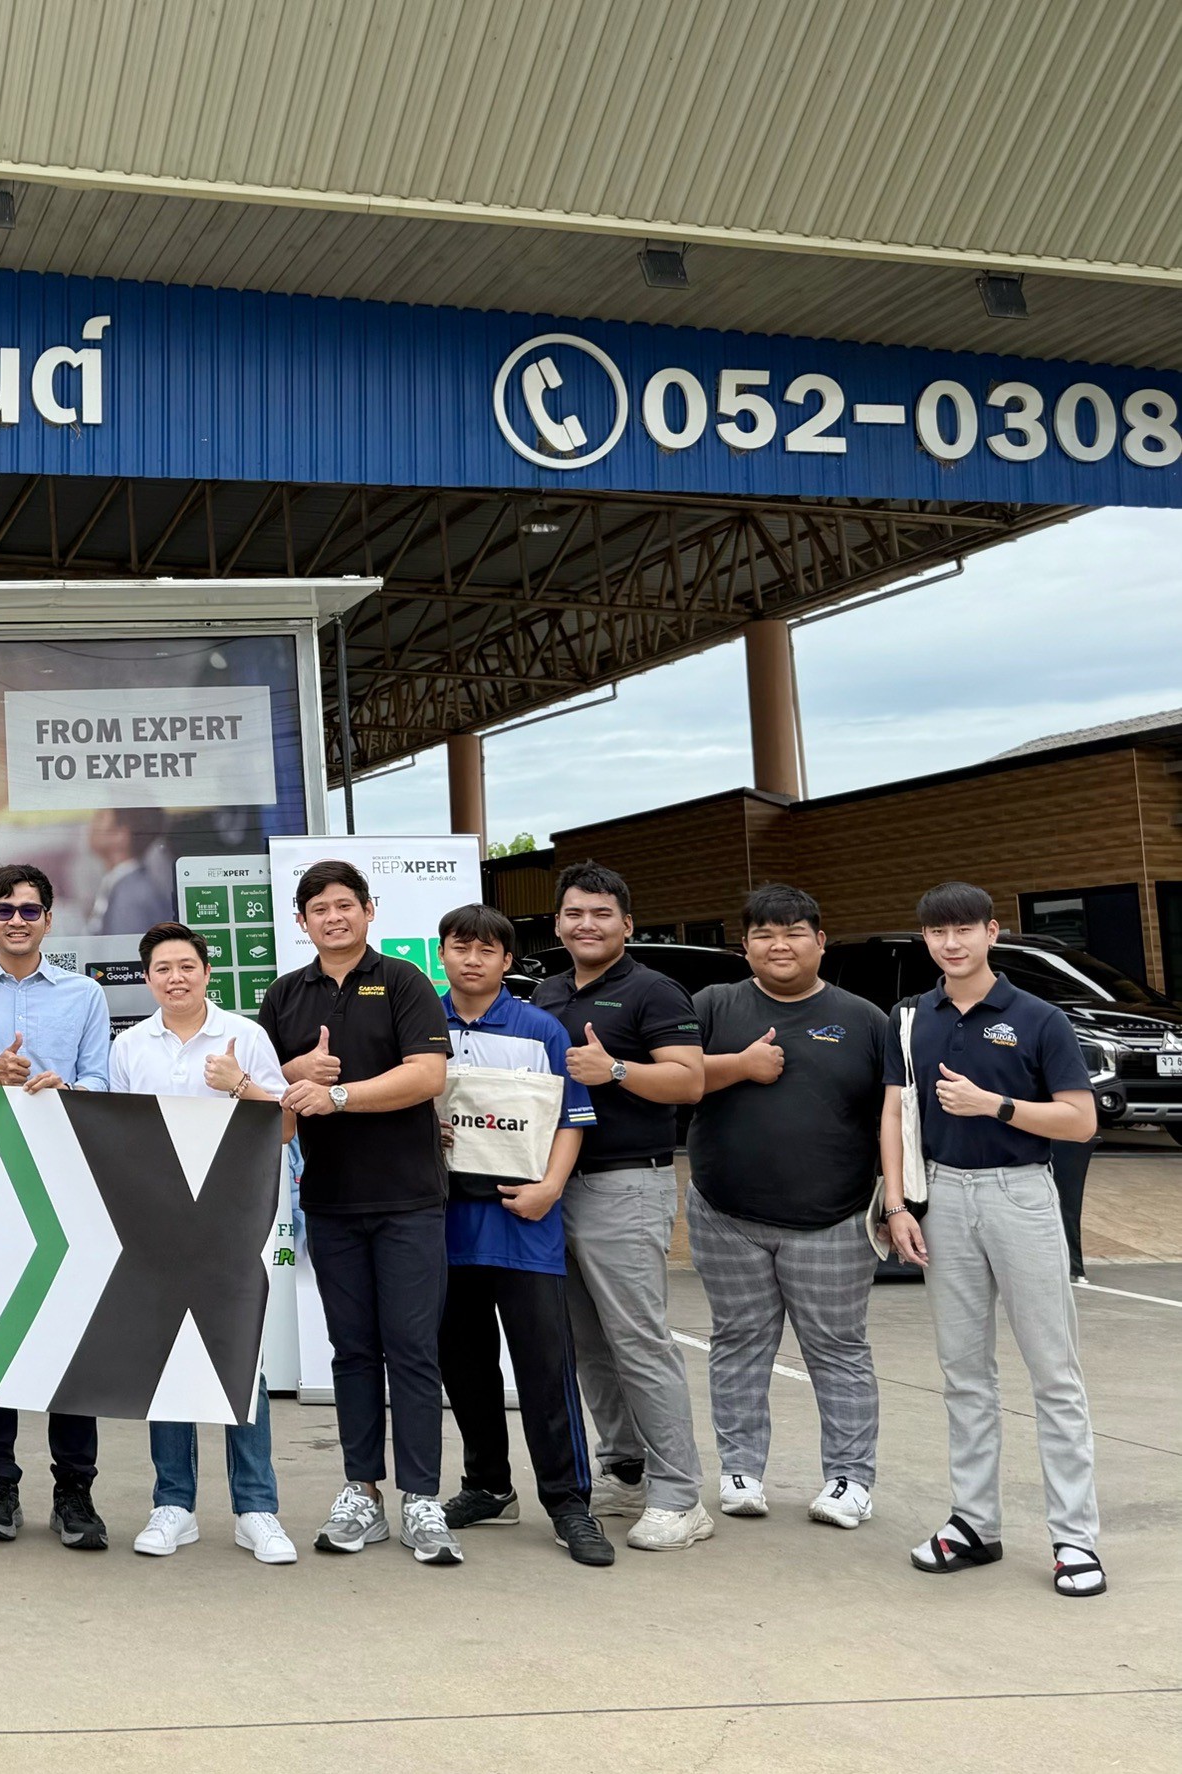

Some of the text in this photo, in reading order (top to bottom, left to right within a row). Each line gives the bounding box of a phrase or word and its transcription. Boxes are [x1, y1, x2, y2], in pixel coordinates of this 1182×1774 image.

[641, 367, 1182, 468] 052-0308
[36, 715, 243, 744] FROM EXPERT
[36, 752, 197, 780] TO EXPERT
[106, 972, 133, 981] Google
[451, 1114, 528, 1131] one2car
